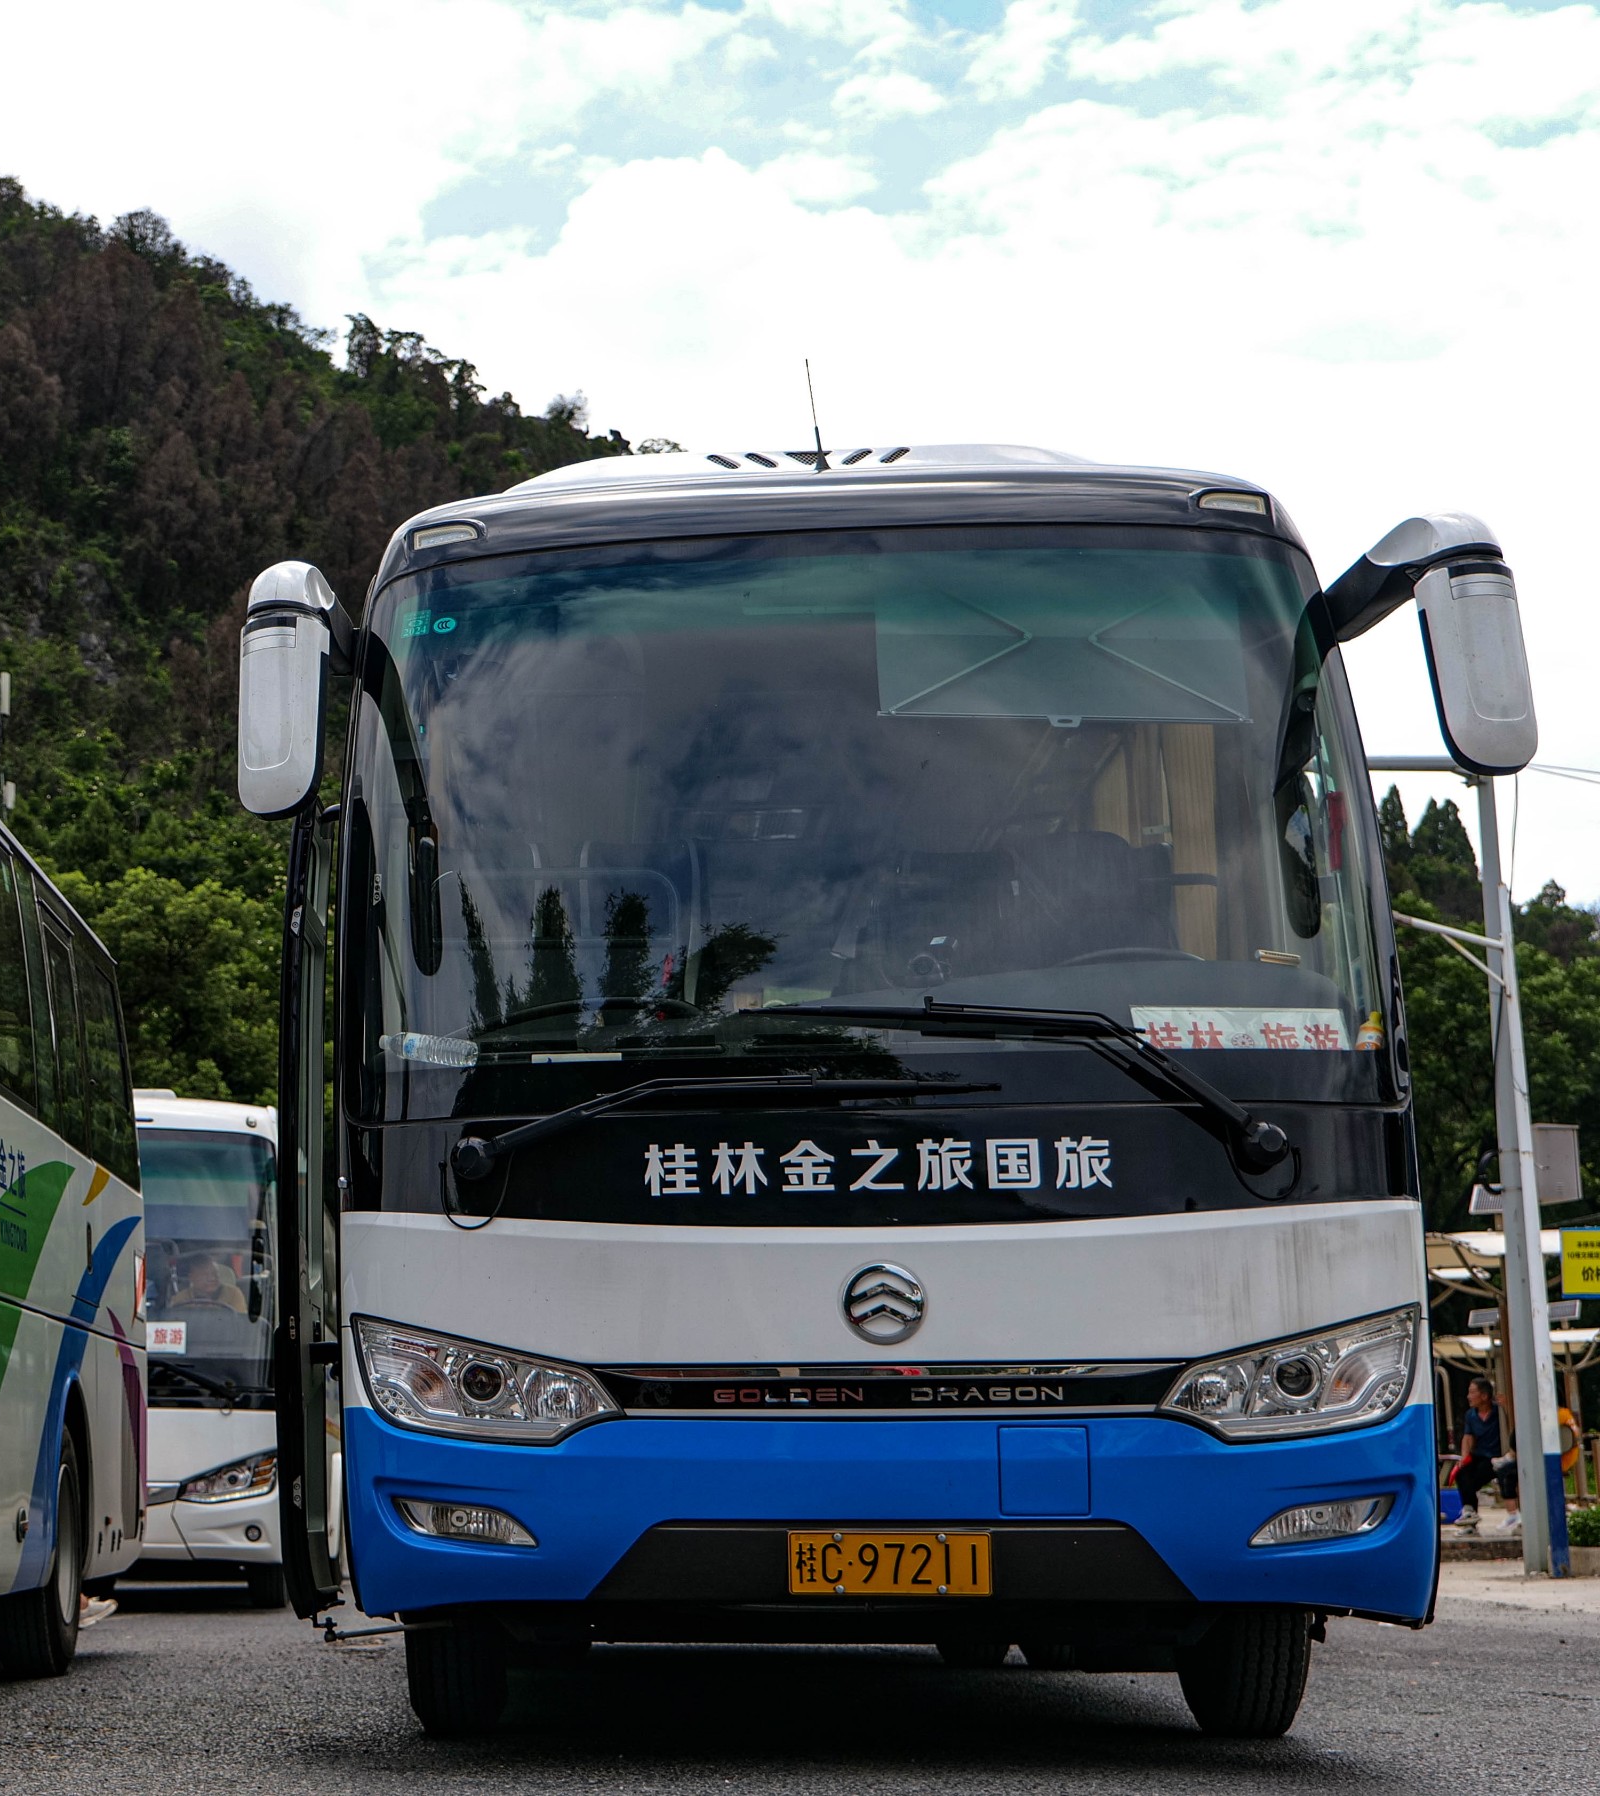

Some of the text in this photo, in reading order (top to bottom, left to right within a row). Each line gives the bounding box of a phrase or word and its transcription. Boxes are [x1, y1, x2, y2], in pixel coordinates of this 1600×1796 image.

[403, 626, 426, 637] 2024
[644, 1136, 1113, 1197] 桂林金之旅国旅
[154, 1328, 183, 1345] 旅游
[713, 1386, 1064, 1403] GOLDEN DRAGON
[795, 1542, 978, 1585] 桂C·97211
